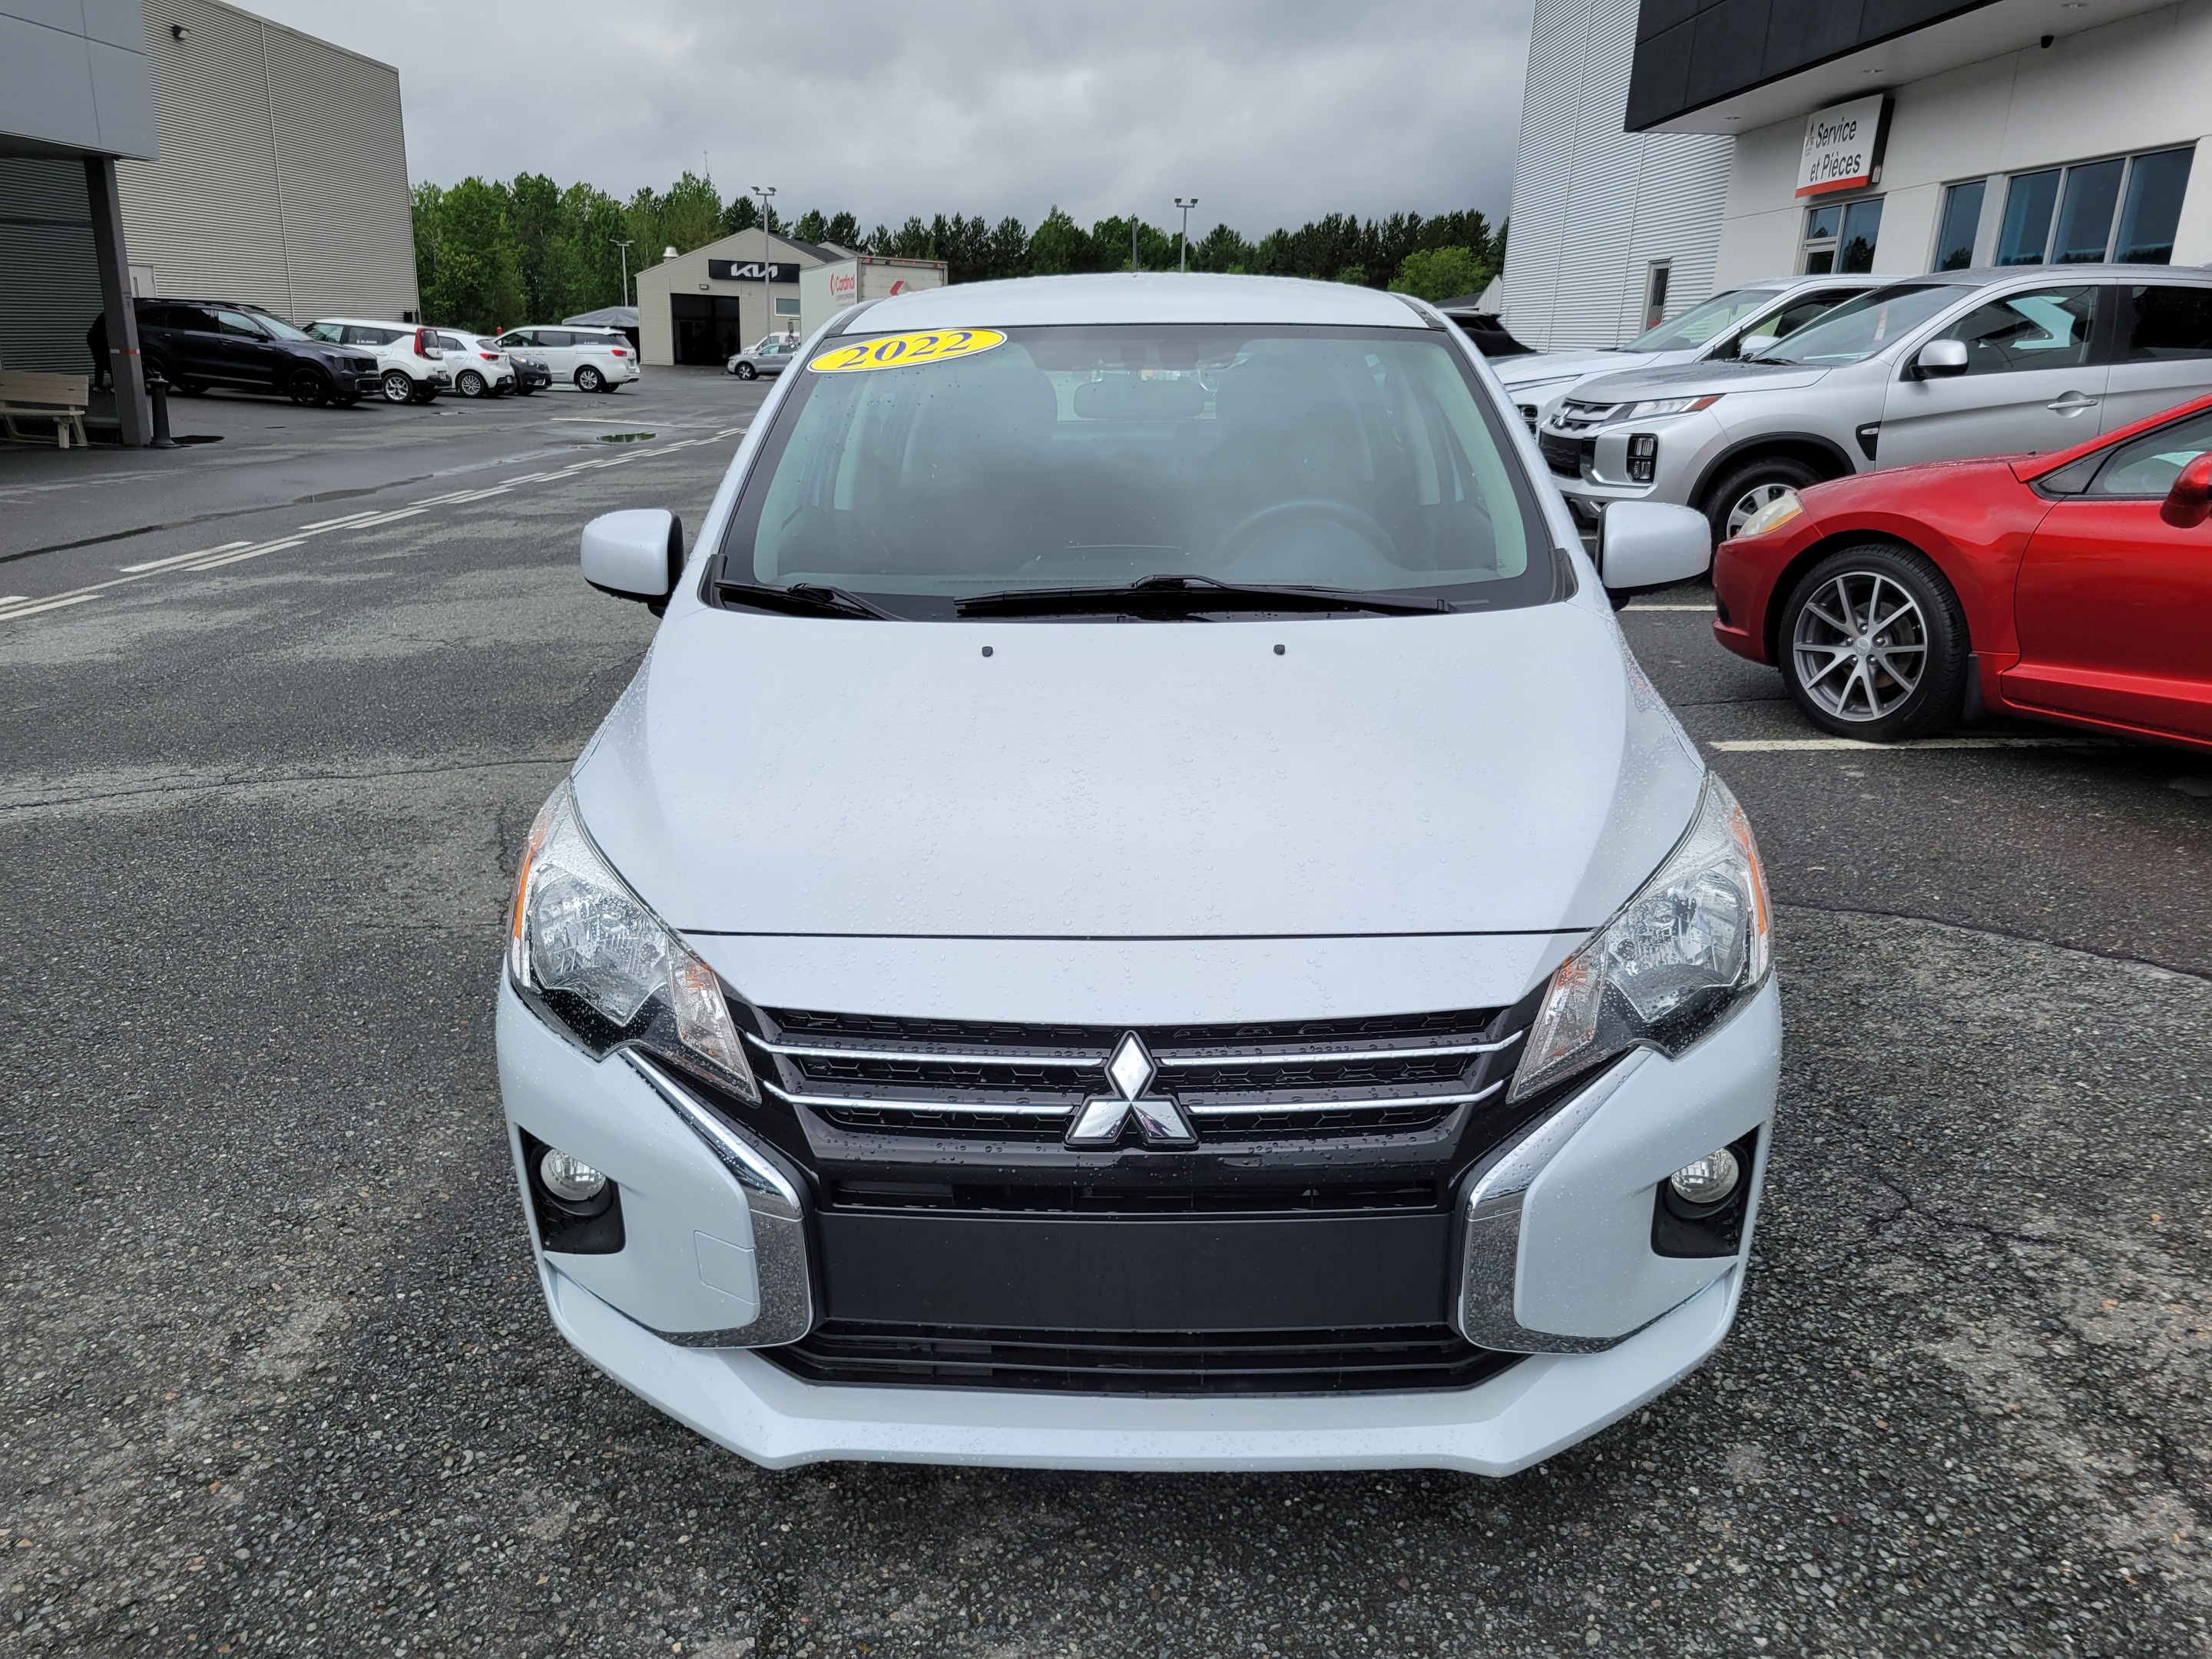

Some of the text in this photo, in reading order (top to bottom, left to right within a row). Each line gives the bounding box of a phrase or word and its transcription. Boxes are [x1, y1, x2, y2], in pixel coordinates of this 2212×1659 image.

[1816, 116, 1857, 149] Service
[1810, 151, 1862, 182] et Pièces
[730, 263, 778, 279] KIA
[836, 273, 855, 292] Cardinal
[836, 331, 973, 369] 2022
